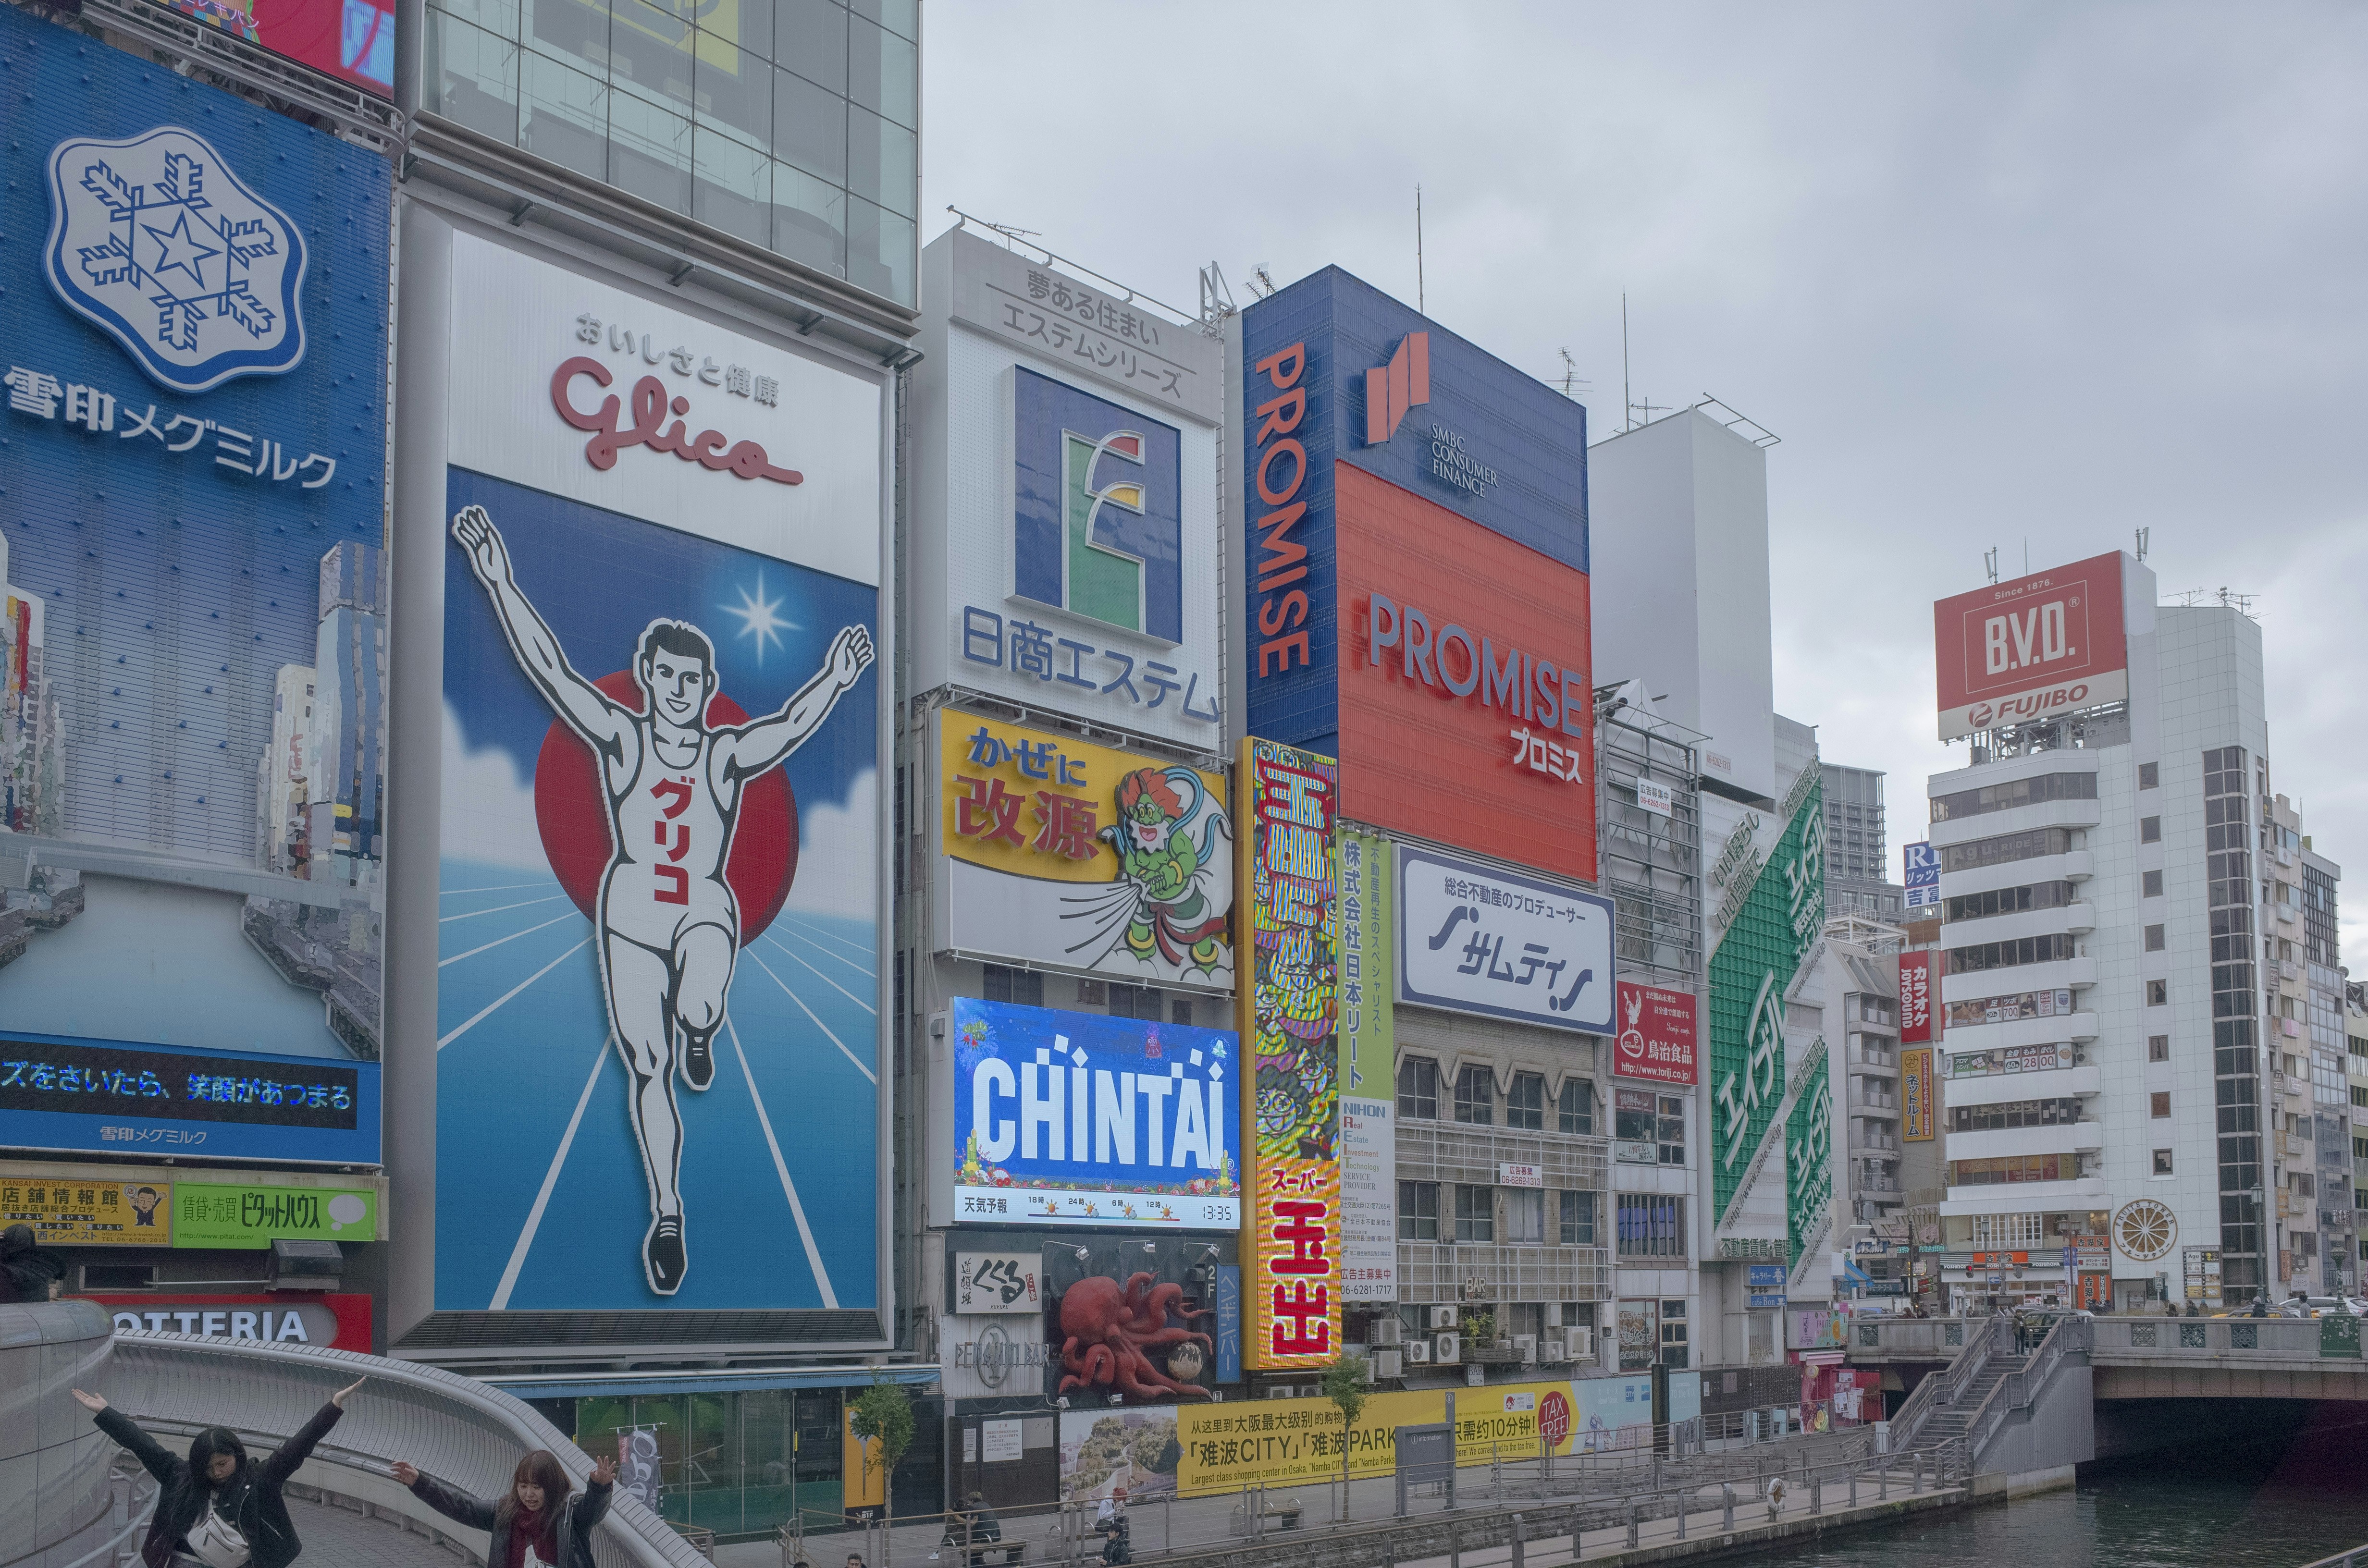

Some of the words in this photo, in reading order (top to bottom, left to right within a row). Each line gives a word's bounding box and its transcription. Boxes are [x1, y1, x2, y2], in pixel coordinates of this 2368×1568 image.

[1027, 269, 1159, 345] 夢ある住まい
[577, 312, 779, 408] おいしさと健康
[1003, 303, 1181, 399] エステムシリーズ
[4, 365, 336, 489] 雪印メグミルク
[552, 356, 804, 485] Glico
[1431, 423, 1464, 452] SMBC
[1431, 442, 1498, 488] CONSUMER
[1431, 458, 1487, 500] FINANCE
[1256, 341, 1309, 679] PROMISE
[1995, 586, 2023, 600] Since
[2027, 578, 2053, 591] 1876.
[1985, 600, 2075, 675] B.V.D.
[963, 605, 1220, 723] 日商エステム
[1368, 591, 1582, 738] PROMISE
[1998, 685, 2088, 719] FUJIBO
[967, 726, 1086, 788] かぜに
[1510, 727, 1583, 784] プロミス
[1640, 784, 1669, 801] 広告募集中
[953, 774, 1099, 861] 改源
[650, 775, 695, 906] グリコ
[1711, 812, 1760, 887] いい暮らし
[1784, 812, 1826, 899] エイブル
[1444, 876, 1586, 924] 総合不動産のプロデューサー
[1716, 847, 1764, 930] いい部屋で
[1793, 889, 1823, 937] 株式会社
[1370, 847, 1381, 1037] 不動産再生のスペシャリスト
[1456, 931, 1566, 990] サムティ
[1344, 840, 1364, 1091] 株式会社日本リート
[1793, 941, 1825, 998] www.able.co.jp
[1901, 969, 1913, 1028] JOYSOUND
[1913, 967, 1929, 1027] カラオケ
[1648, 1039, 1692, 1065] 鳥治食品
[1715, 990, 1788, 1141] エイブル
[187, 1074, 351, 1110] 笑顔があつまる
[973, 1034, 1223, 1169] CHINTAI
[1344, 1102, 1385, 1118] NIHON
[1905, 1074, 1921, 1137] ネットルーム
[99, 1126, 207, 1145] 雪印メグミルク
[1344, 1116, 1363, 1129] Real
[1344, 1130, 1369, 1144] Estate
[1343, 1157, 1380, 1172] Technology
[1344, 1143, 1379, 1158] Investment
[1270, 1168, 1328, 1193] スーパー
[1344, 1172, 1370, 1181] SERVICE
[1344, 1181, 1376, 1190] PROVIDER
[1502, 1176, 1541, 1186] 06-6262-1313
[1509, 1165, 1533, 1176] 広告募集
[1727, 1124, 1783, 1229] http://www.able.co.jp
[1, 1188, 119, 1205] 店舗情報館
[1, 1204, 119, 1213] 居抜き店舗総合プロデュース
[242, 1192, 321, 1228] ピタットハウス
[964, 1197, 1007, 1214] 天気予報
[1068, 1198, 1085, 1206] 24時
[1146, 1200, 1160, 1209] 12時
[1203, 1205, 1231, 1221] 13:35
[2116, 1202, 2140, 1226] FRUITS
[2147, 1202, 2174, 1224] TOWER
[34, 1231, 97, 1240] 西インベスト
[180, 1232, 254, 1240] http://www.pitat.com/
[1796, 1217, 1833, 1286] www.a-hosho.co.jp
[972, 1259, 1026, 1304] くくる
[1208, 1265, 1215, 1298] 2F
[1267, 1199, 1332, 1356] 玉出
[1341, 1268, 1391, 1280] 広告主募集中
[1341, 1285, 1392, 1295] 06-6281-1717
[1466, 1277, 1485, 1292] BAR
[1763, 1297, 1775, 1306] Bon
[1221, 1275, 1236, 1371] ペンギンバー
[1468, 1366, 1483, 1375] BAR
[1542, 1396, 1564, 1421] TAX
[1418, 1433, 1442, 1442] information
[1456, 1446, 1468, 1457] here!
[1469, 1447, 1476, 1456] We
[1525, 1441, 1535, 1449] free.
[1191, 1474, 1215, 1485] Largest
[1216, 1472, 1232, 1482] class
[1234, 1469, 1260, 1482] shopping
[1262, 1467, 1281, 1479] center
[1282, 1465, 1287, 1475] in
[1289, 1462, 1307, 1475] Osaka,
[1347, 1458, 1357, 1469] and
